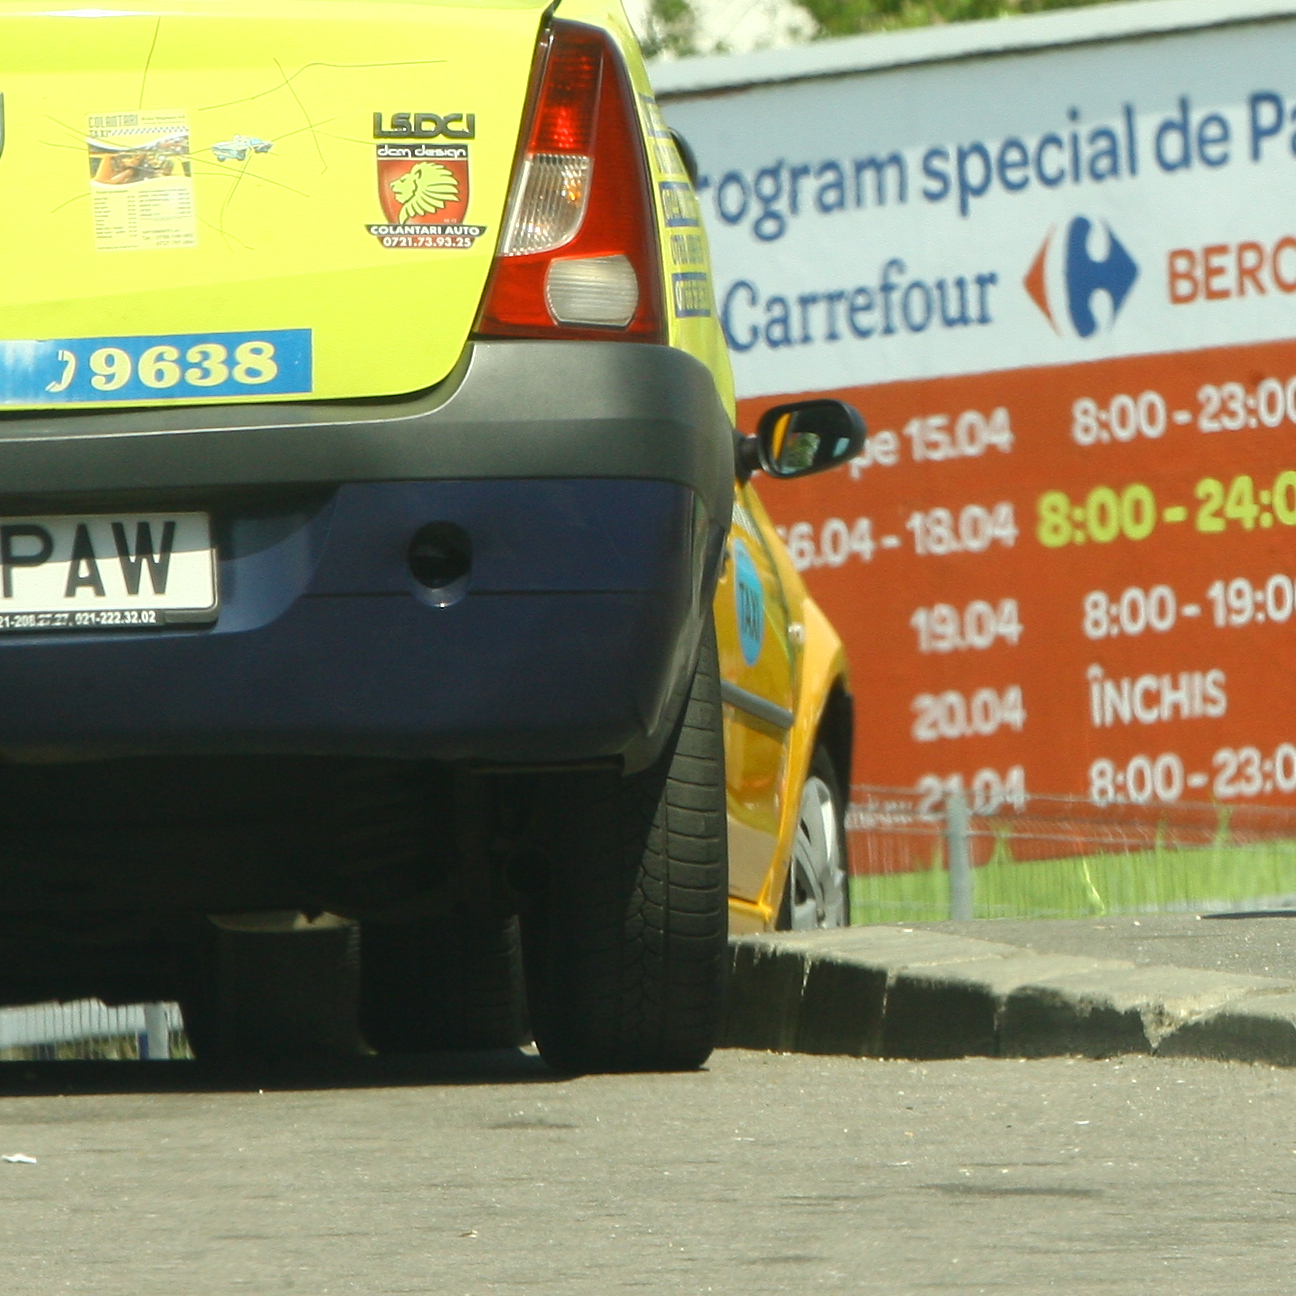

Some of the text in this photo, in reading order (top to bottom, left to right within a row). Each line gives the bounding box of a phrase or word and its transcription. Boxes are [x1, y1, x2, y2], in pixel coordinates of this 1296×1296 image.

[414, 144, 467, 160] design
[921, 103, 1140, 218] special
[1154, 95, 1232, 174] de
[370, 225, 480, 236] COLANTARI AUTO
[383, 236, 472, 247] 0721.73.93.25
[721, 258, 999, 353] Carrefour
[88, 340, 279, 391] 9638
[903, 405, 1016, 462] 15.04
[0, 520, 177, 599] PAW
[910, 596, 1024, 654] 19.04
[910, 684, 1026, 742] 20.04
